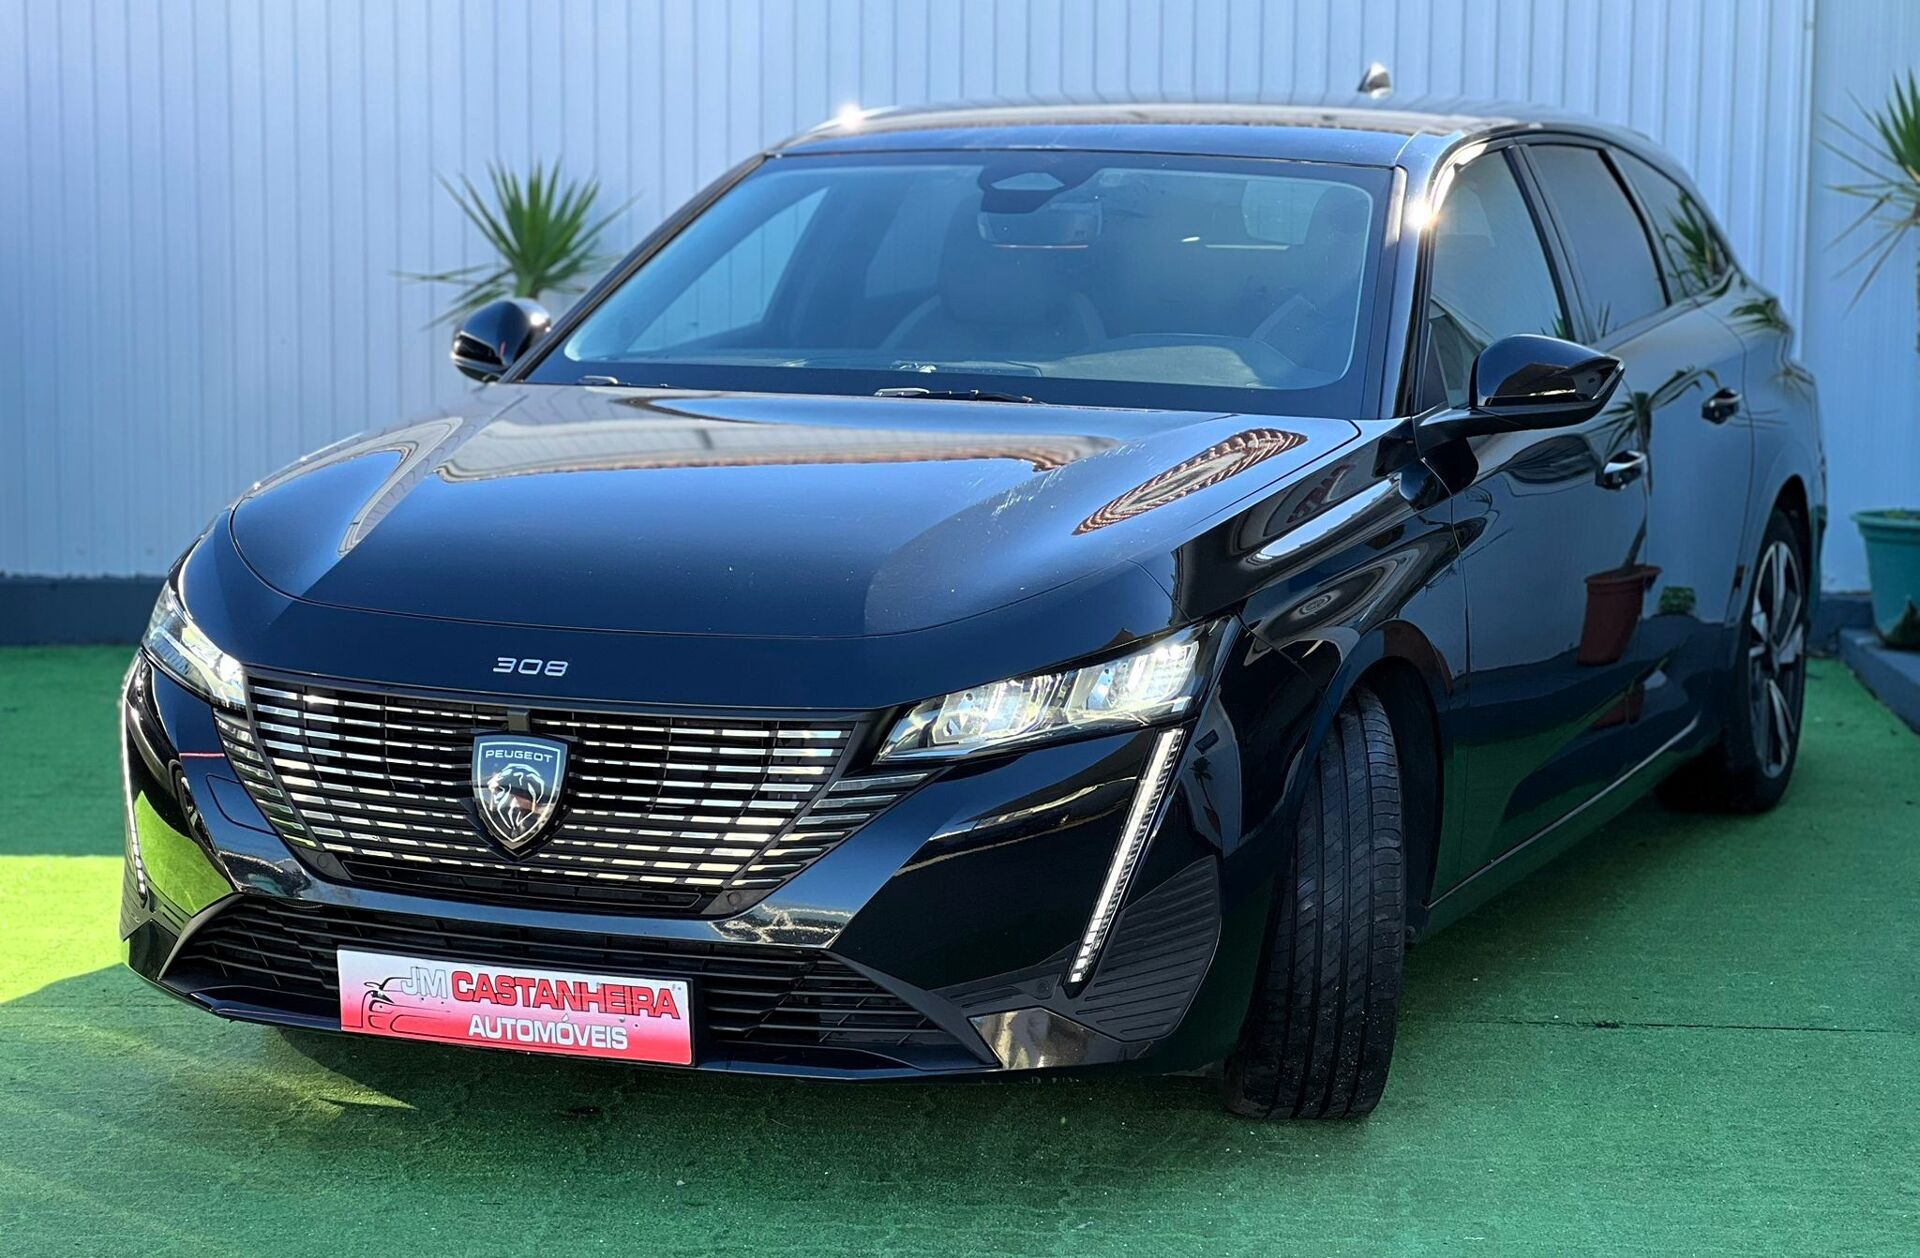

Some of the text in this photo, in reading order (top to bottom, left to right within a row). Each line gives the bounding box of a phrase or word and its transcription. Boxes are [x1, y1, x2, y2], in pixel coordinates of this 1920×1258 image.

[492, 656, 569, 677] 308
[485, 749, 553, 763] PEUGEOT
[400, 966, 680, 1020] JM CASTANHEIRA
[468, 1013, 628, 1050] AUTOMÓVEIS
